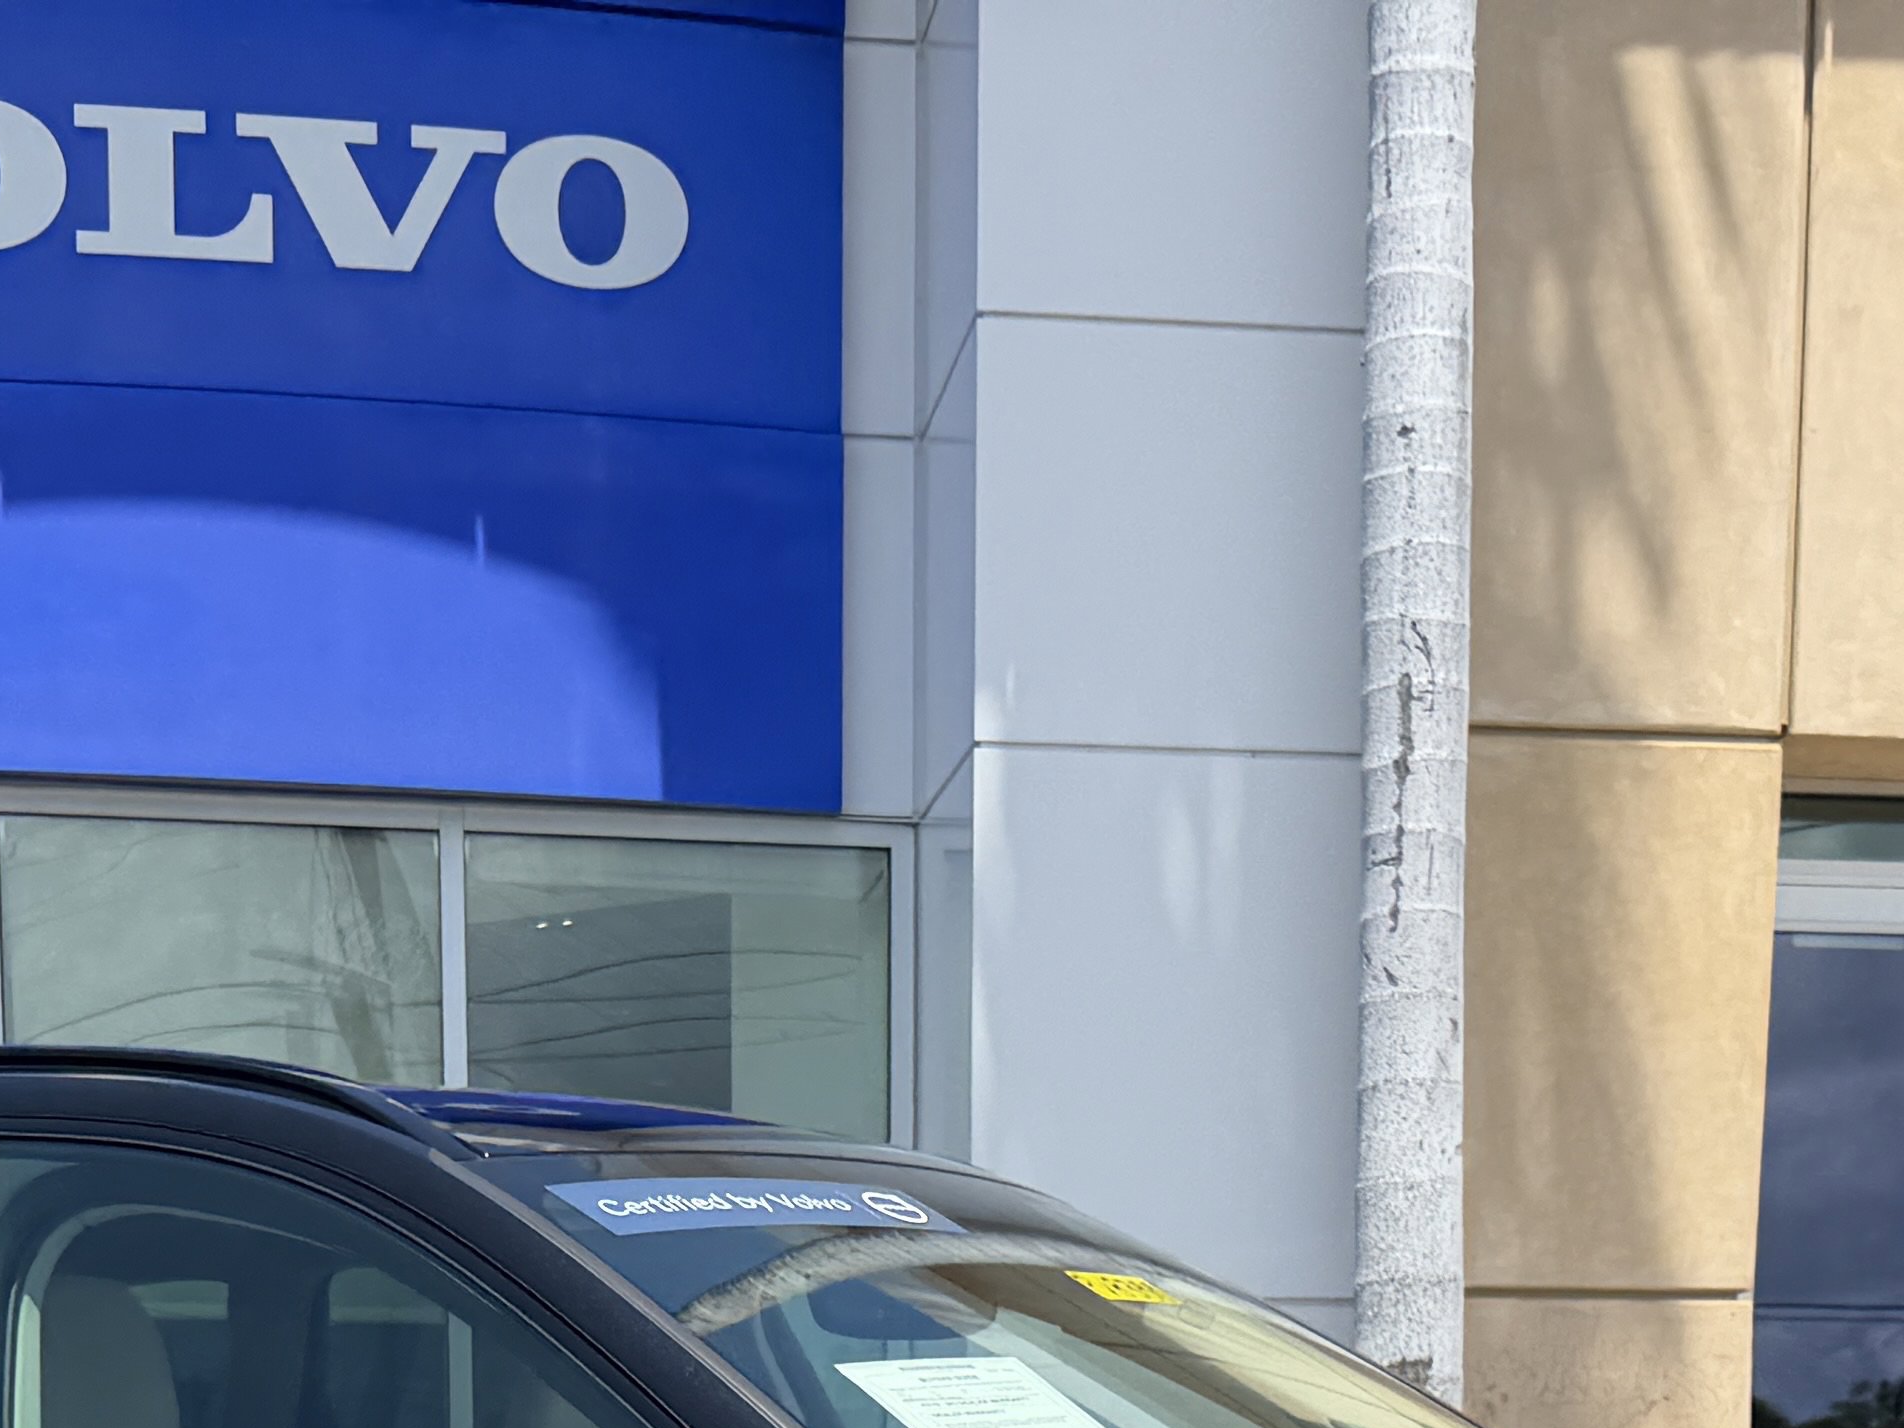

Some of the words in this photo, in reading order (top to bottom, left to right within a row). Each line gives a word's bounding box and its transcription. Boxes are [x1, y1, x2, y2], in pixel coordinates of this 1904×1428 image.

[597, 1193, 729, 1217] Certified
[725, 1192, 774, 1214] by
[768, 1193, 853, 1212] Volvo
